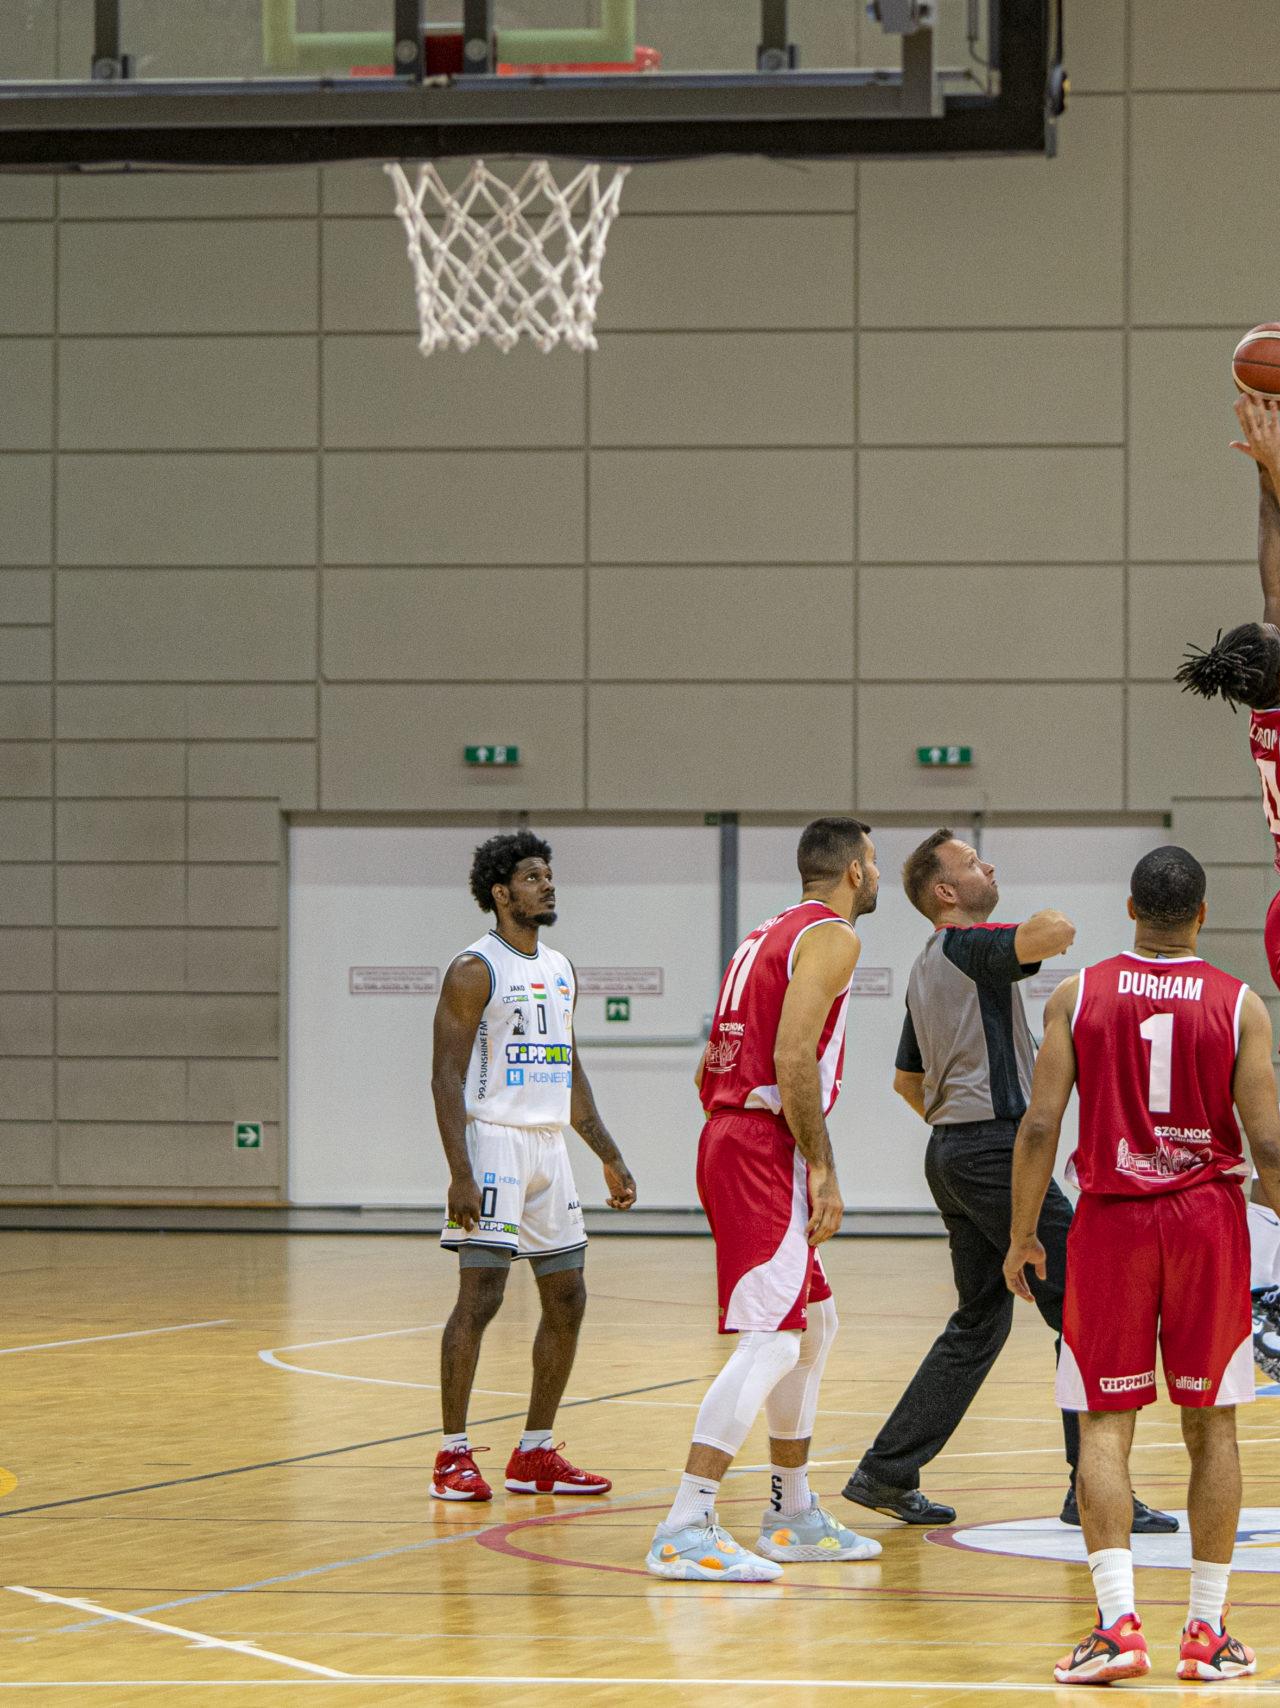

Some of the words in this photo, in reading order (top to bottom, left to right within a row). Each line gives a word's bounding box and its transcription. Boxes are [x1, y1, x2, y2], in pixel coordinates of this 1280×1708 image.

[719, 933, 768, 1016] 11
[1117, 970, 1204, 1000] DURHAM
[1139, 1013, 1174, 1113] 1
[1153, 1126, 1212, 1140] SZOLNOK
